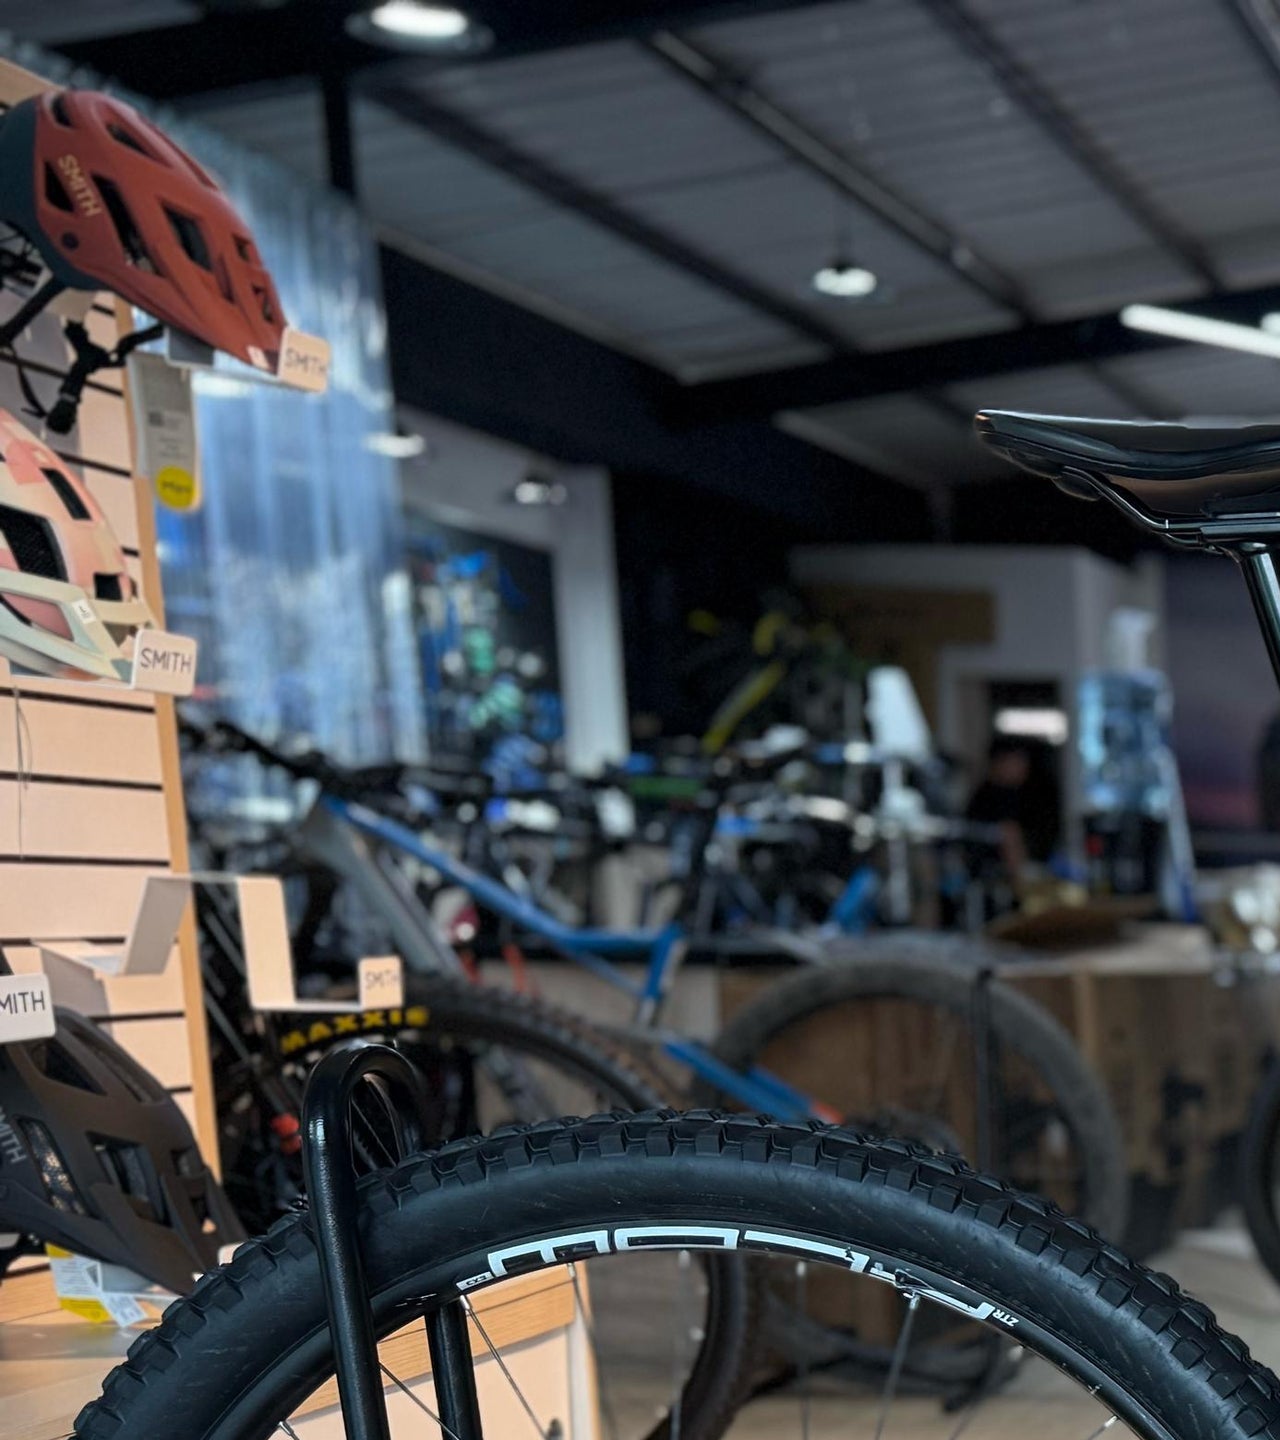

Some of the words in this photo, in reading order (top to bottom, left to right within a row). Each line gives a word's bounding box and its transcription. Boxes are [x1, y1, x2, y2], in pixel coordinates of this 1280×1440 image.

[58, 154, 103, 216] SMITH
[140, 647, 193, 674] SMITH
[281, 1006, 429, 1054] MAXXIS
